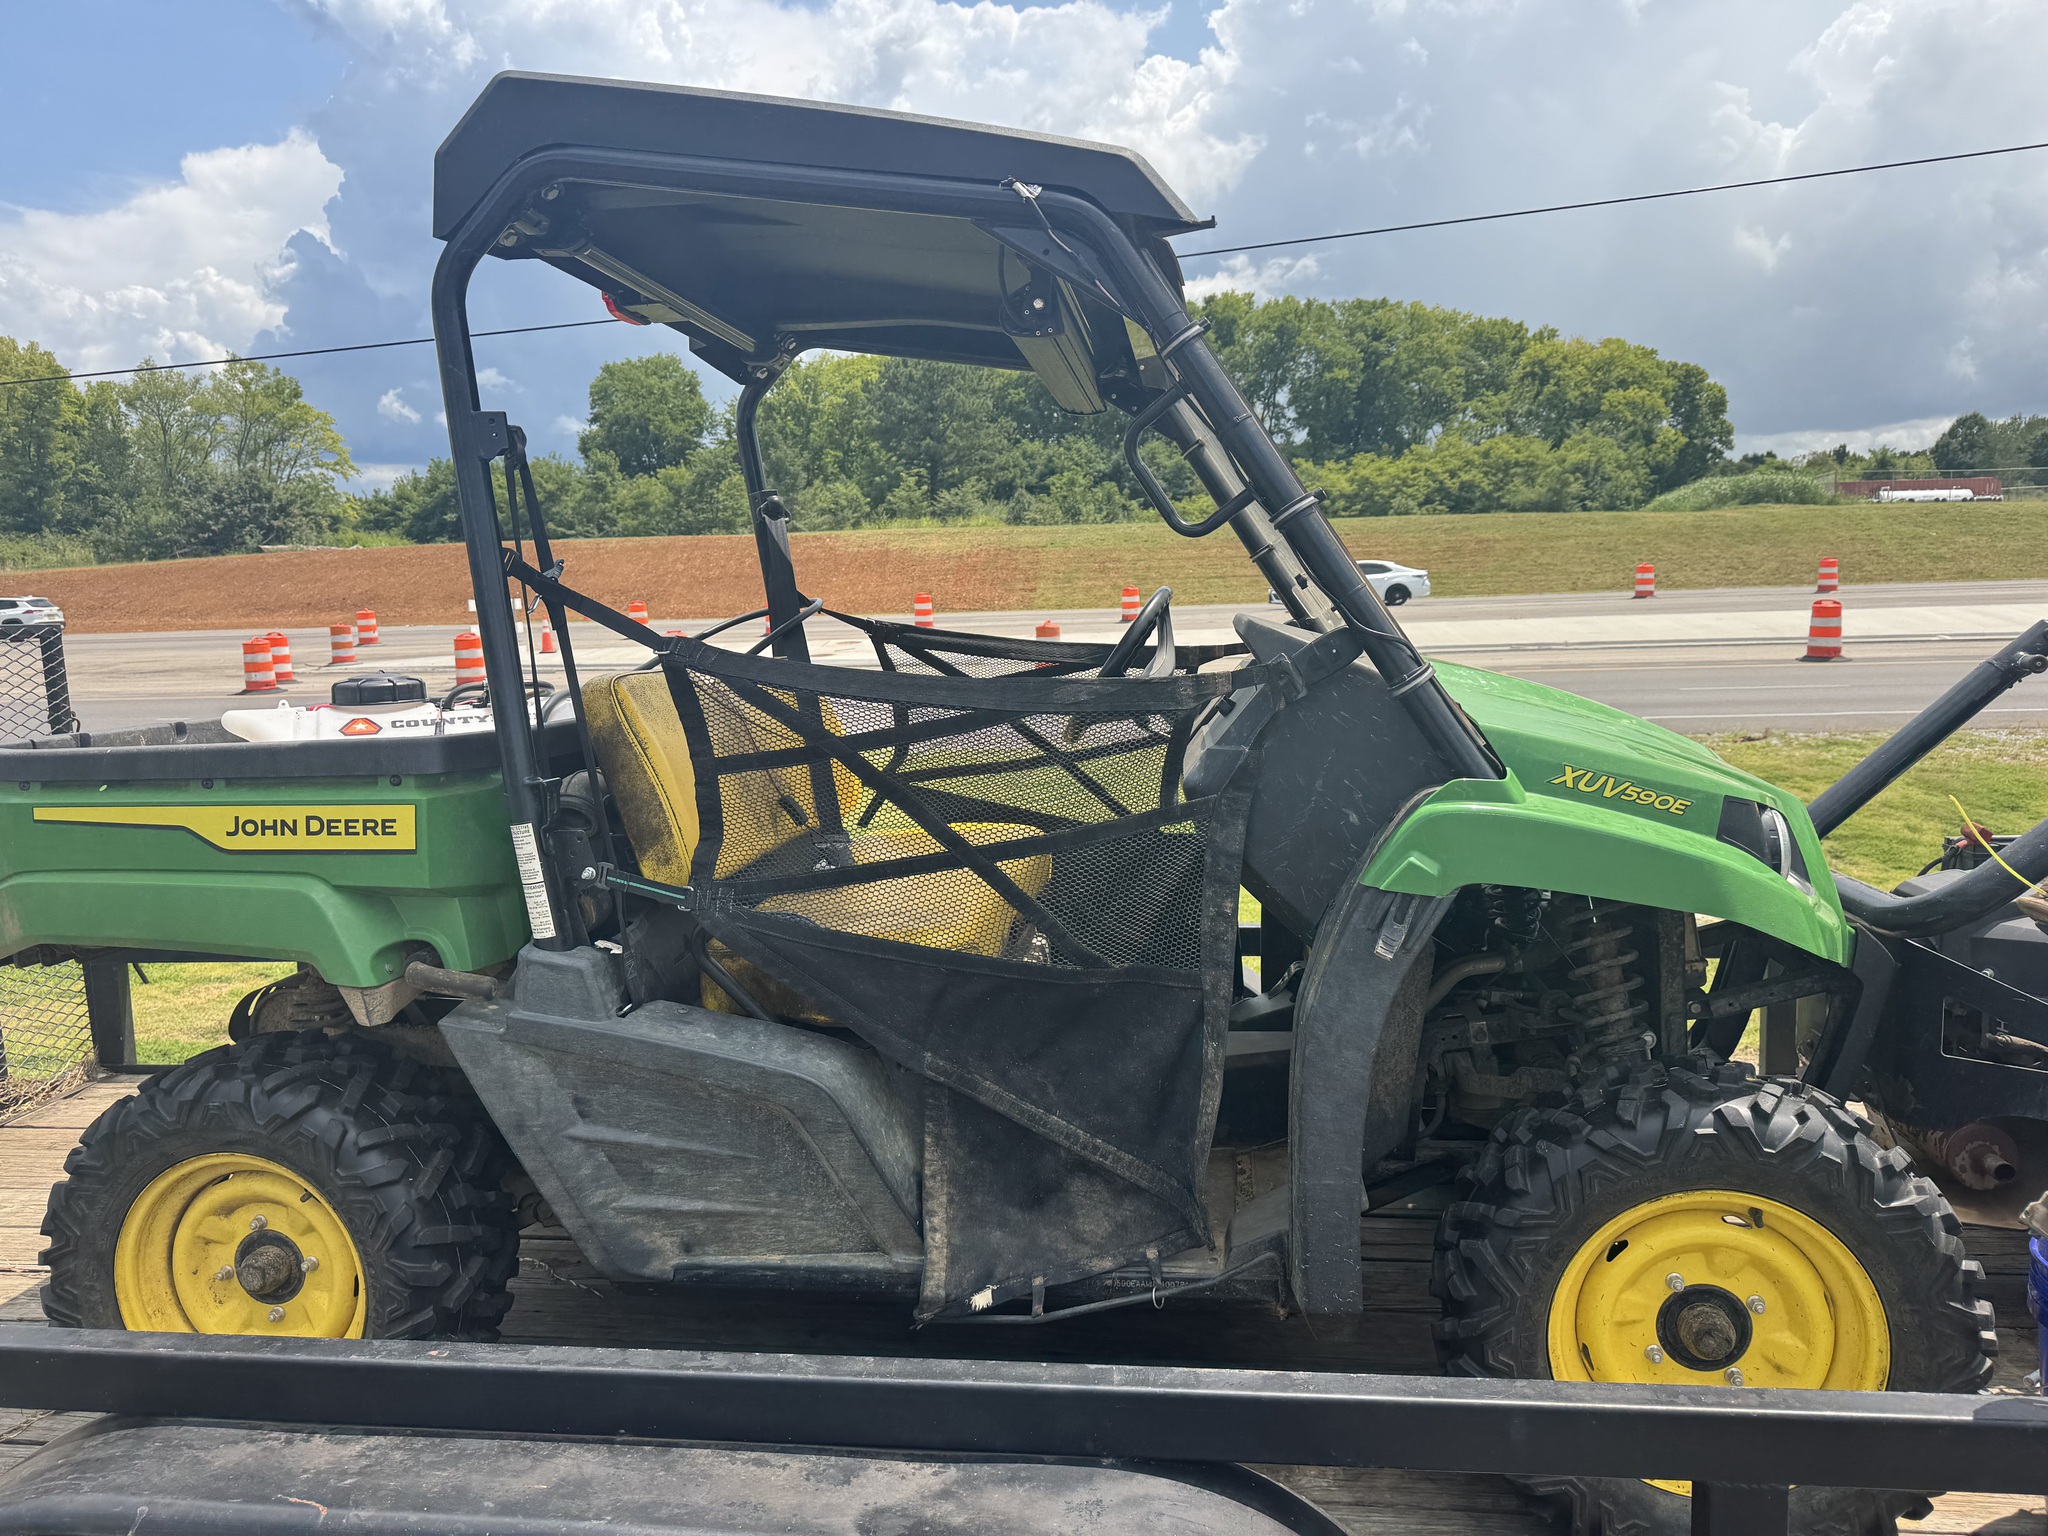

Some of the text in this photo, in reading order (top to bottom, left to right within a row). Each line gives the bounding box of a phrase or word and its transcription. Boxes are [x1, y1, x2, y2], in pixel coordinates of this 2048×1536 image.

[1549, 765, 1692, 815] XUV590E
[226, 815, 397, 837] JOHN DEERE
